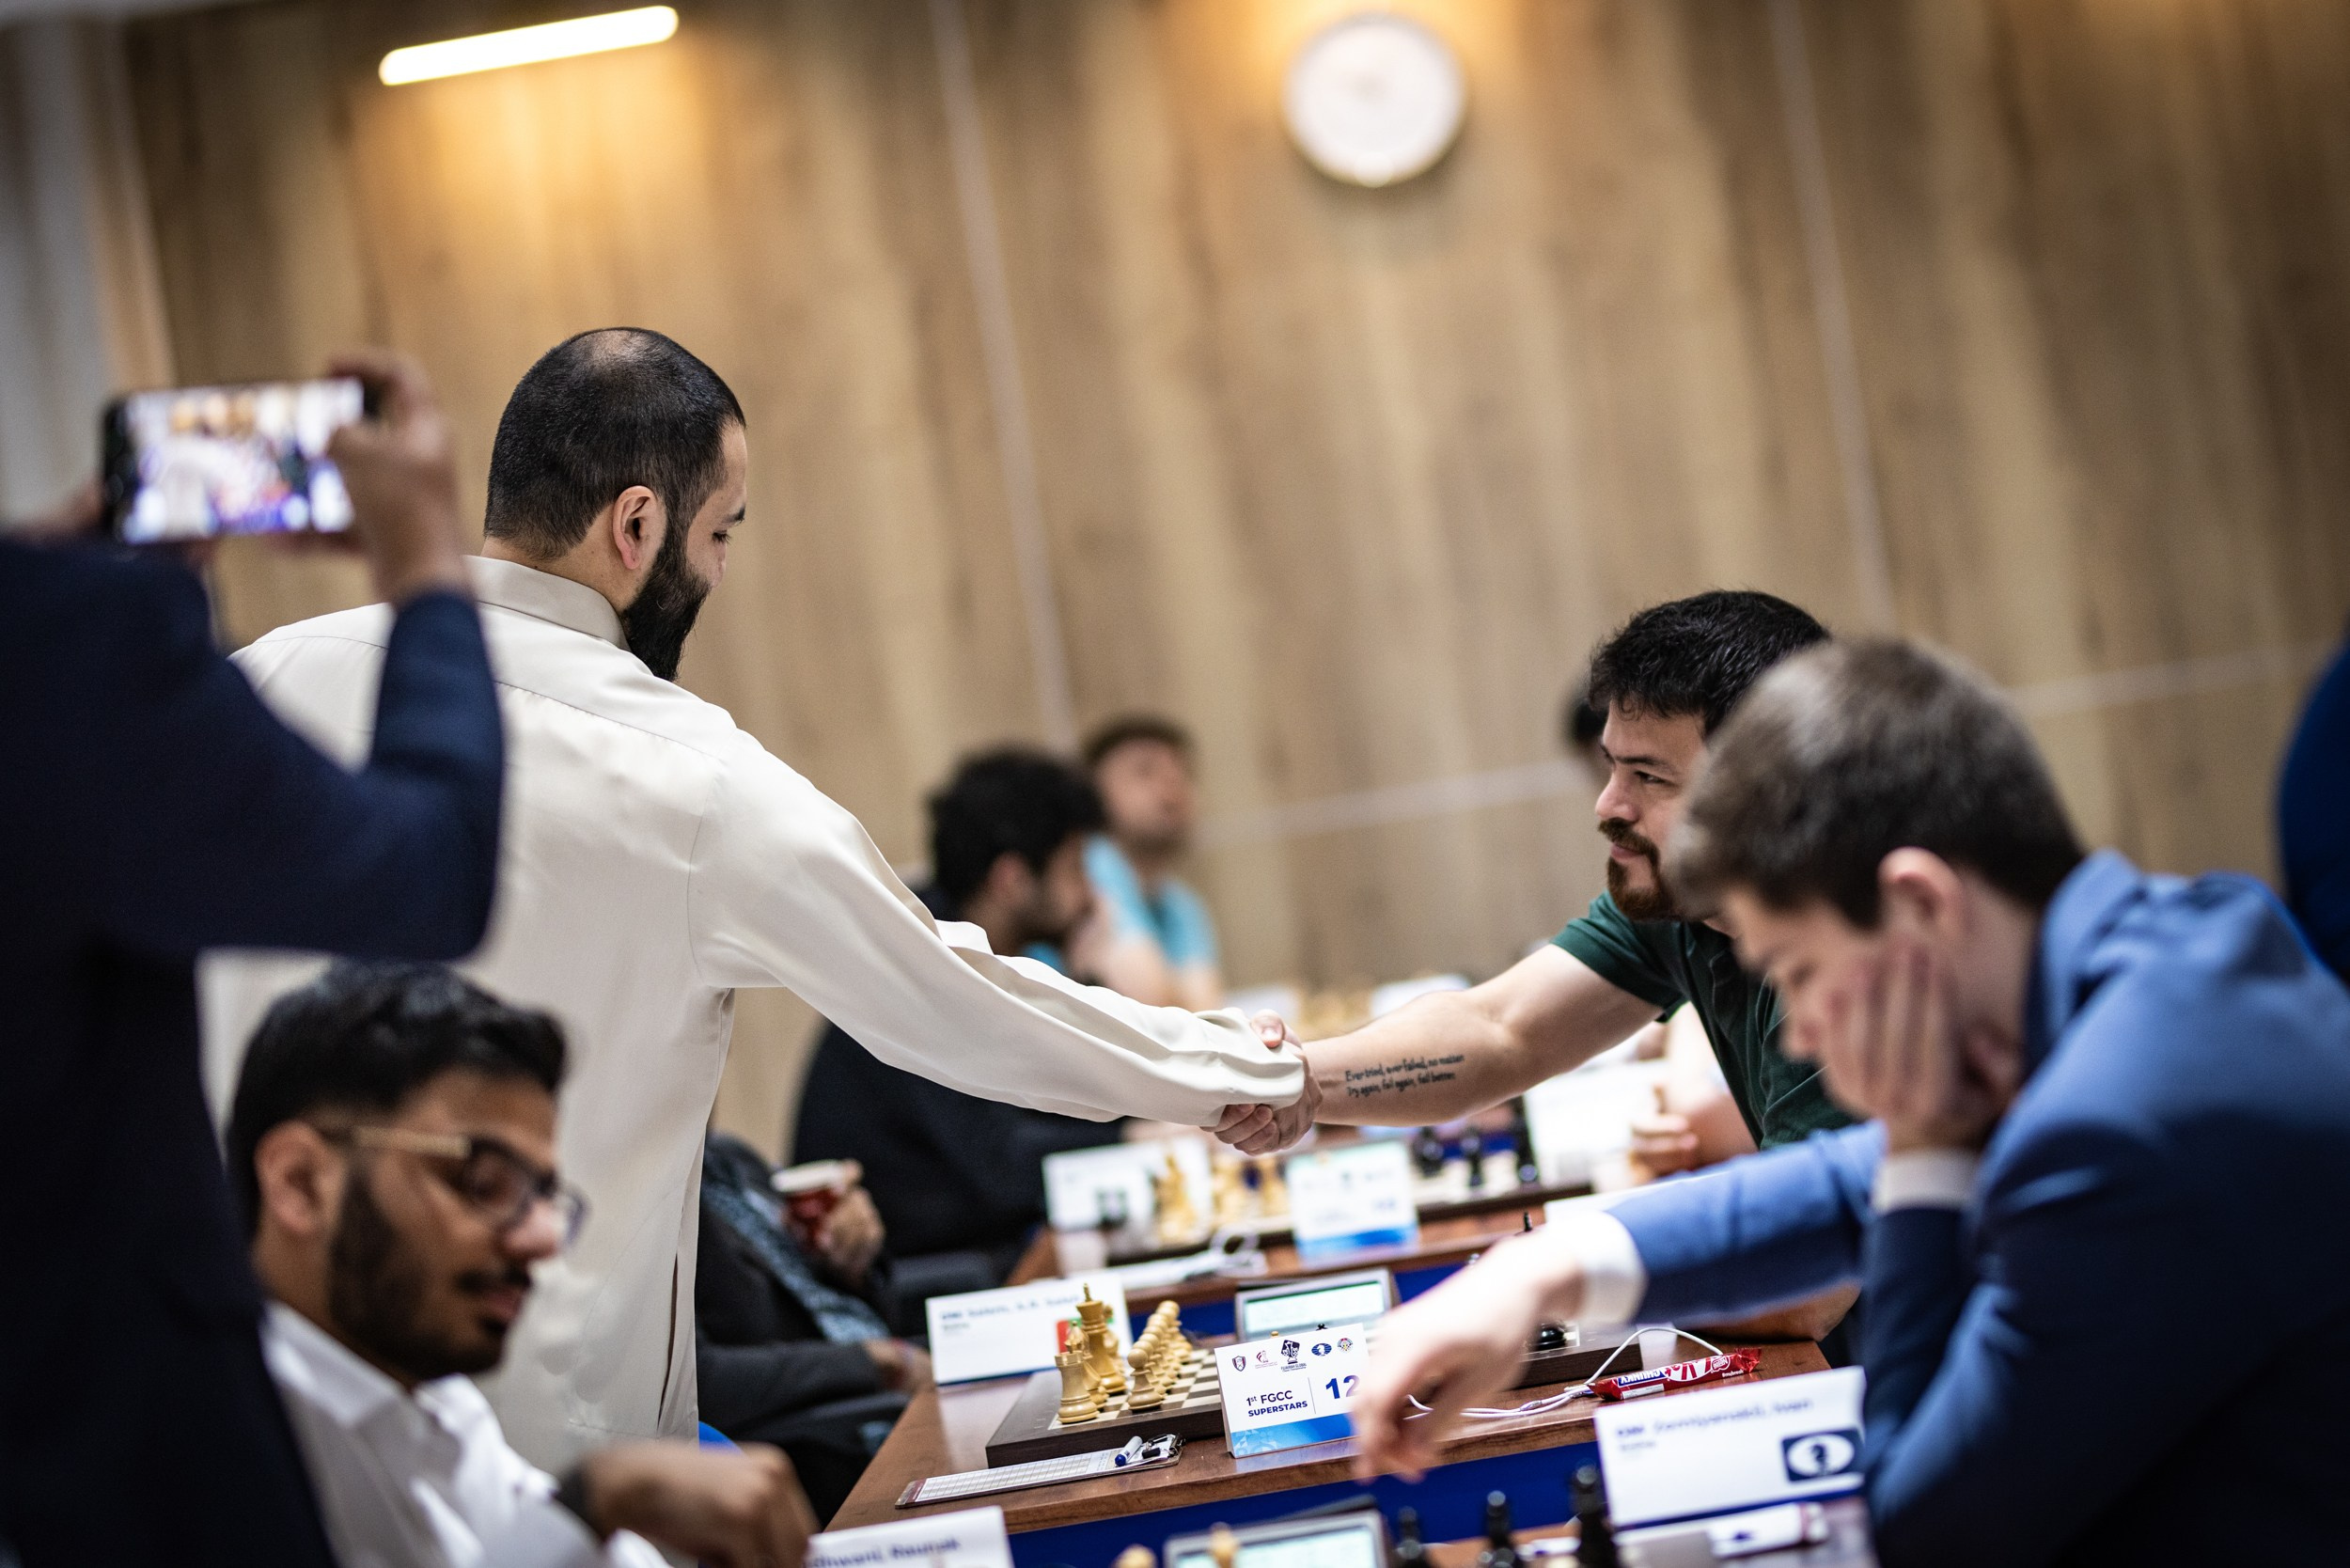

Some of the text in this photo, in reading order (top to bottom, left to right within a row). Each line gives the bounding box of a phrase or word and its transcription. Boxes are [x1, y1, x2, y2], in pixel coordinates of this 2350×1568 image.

[1345, 1070, 1364, 1082] Ever
[1346, 1086, 1360, 1098] Try
[1621, 1370, 1661, 1385] CHUNKY
[1325, 1374, 1361, 1400] 12
[1246, 1390, 1293, 1406] 1st FGCC
[1247, 1401, 1308, 1418] SUPERSTARS
